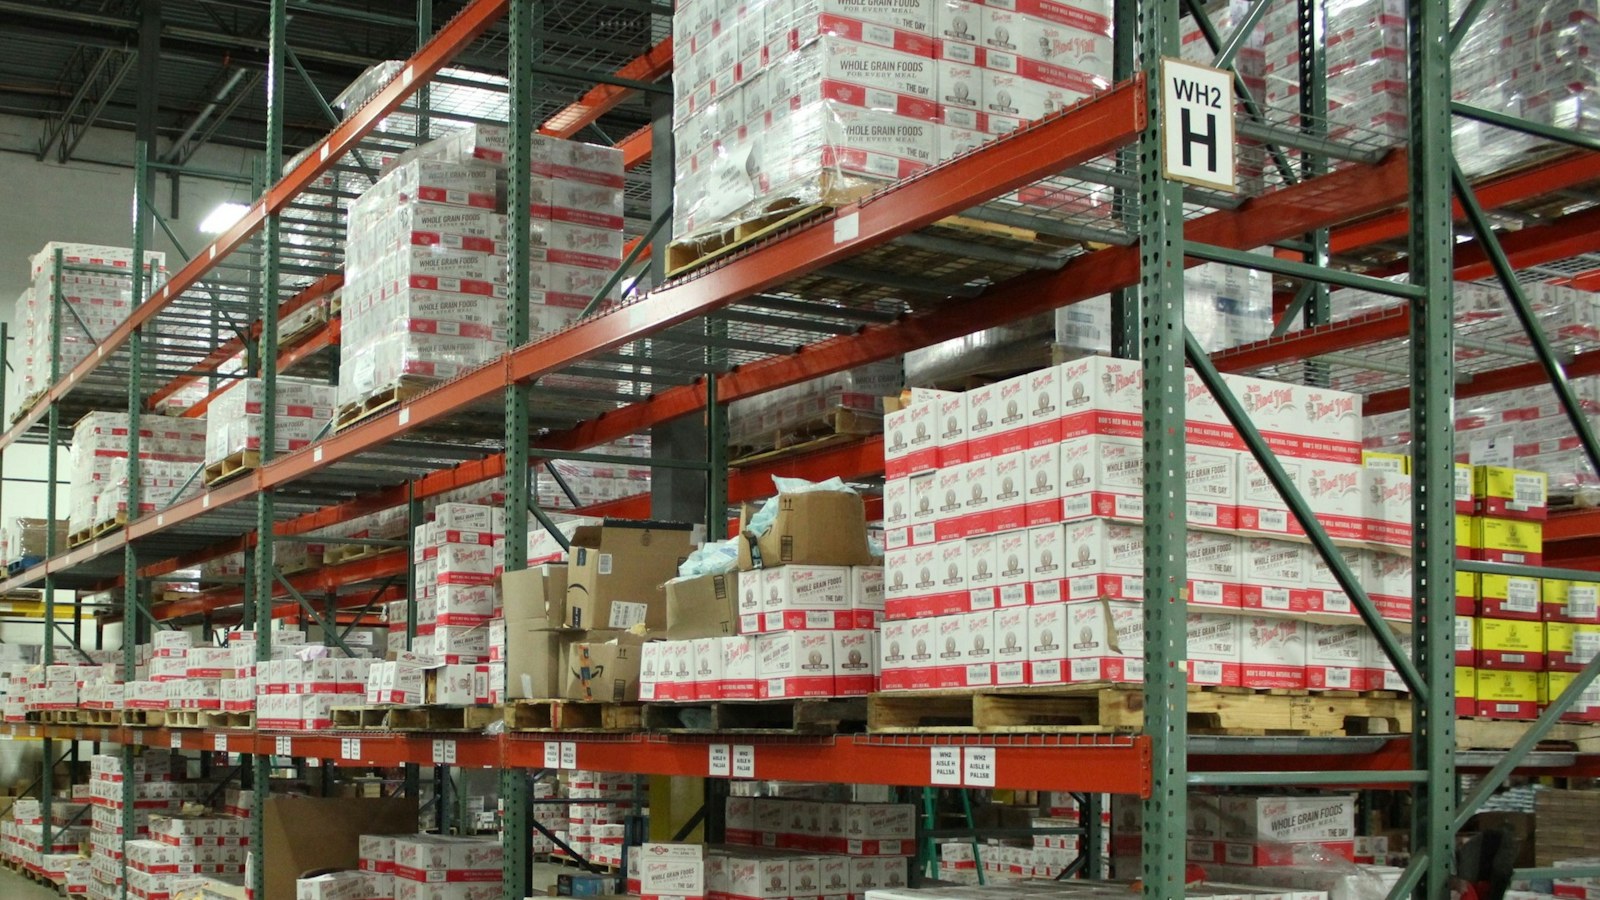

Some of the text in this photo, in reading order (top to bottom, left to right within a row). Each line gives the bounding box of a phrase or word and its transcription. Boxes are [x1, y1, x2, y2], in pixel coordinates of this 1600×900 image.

[894, 0, 920, 8] FOODS
[903, 19, 926, 31] THE DAY
[1052, 38, 1073, 57] Red
[840, 61, 923, 72] WHOLE GRAIN FOODS
[906, 83, 930, 95] THE DAY
[1173, 77, 1221, 109] WH2
[872, 126, 896, 136] GRAIN
[897, 127, 923, 137] FOODS
[1181, 107, 1217, 173] H
[907, 148, 930, 160] THE DAY
[422, 215, 443, 224] WHOLE
[443, 214, 460, 222] GRAIN
[420, 256, 478, 267] WHOLE GRAIN FOODS
[419, 302, 438, 311] WHOLE
[440, 301, 457, 309] GRAIN
[1115, 371, 1136, 392] Red
[1254, 391, 1273, 411] Red
[1274, 387, 1294, 409] Mill
[1316, 401, 1334, 420] Red
[1335, 396, 1354, 417] Mill
[1098, 416, 1112, 424] BOB'S
[1204, 429, 1221, 437] NATURAL
[1222, 431, 1234, 439] FOODS
[1287, 439, 1299, 447] FOODS
[1332, 445, 1348, 453] NATURAL
[1106, 459, 1139, 472] WHOLE GRAIN
[1197, 465, 1227, 477] GRAIN FOODS
[1250, 477, 1267, 489] WHOLE
[1319, 476, 1338, 497] Red
[1338, 471, 1359, 492] Mill
[1208, 485, 1227, 494] THE DAY
[1335, 521, 1350, 529] NATURAL
[1114, 540, 1142, 553] WHOLE GRA
[1202, 547, 1215, 556] GRAIN
[1217, 543, 1232, 553] FOODS
[1254, 550, 1299, 566] WHOLE GRAIN FOODS
[1214, 564, 1232, 573] THE DAY
[1291, 571, 1299, 579] DAY
[797, 576, 842, 593] WHOLE GRAIN FOODS
[866, 584, 880, 593] WHOLE
[1202, 625, 1215, 635] GRAIN
[1217, 621, 1232, 631] FOODS
[1261, 627, 1279, 646] Red
[1279, 621, 1297, 642] Mill
[1318, 636, 1331, 646] WHOLE
[1223, 644, 1232, 652] DAY
[1276, 671, 1290, 679] NATURAL
[1271, 804, 1343, 831] WHOLE GRAIN FOODS
[1277, 817, 1336, 837] FOR EVERY MEAL
[1328, 828, 1348, 837] THE DAY
[651, 872, 666, 881] WHOLE
[667, 870, 680, 878] GRAIN
